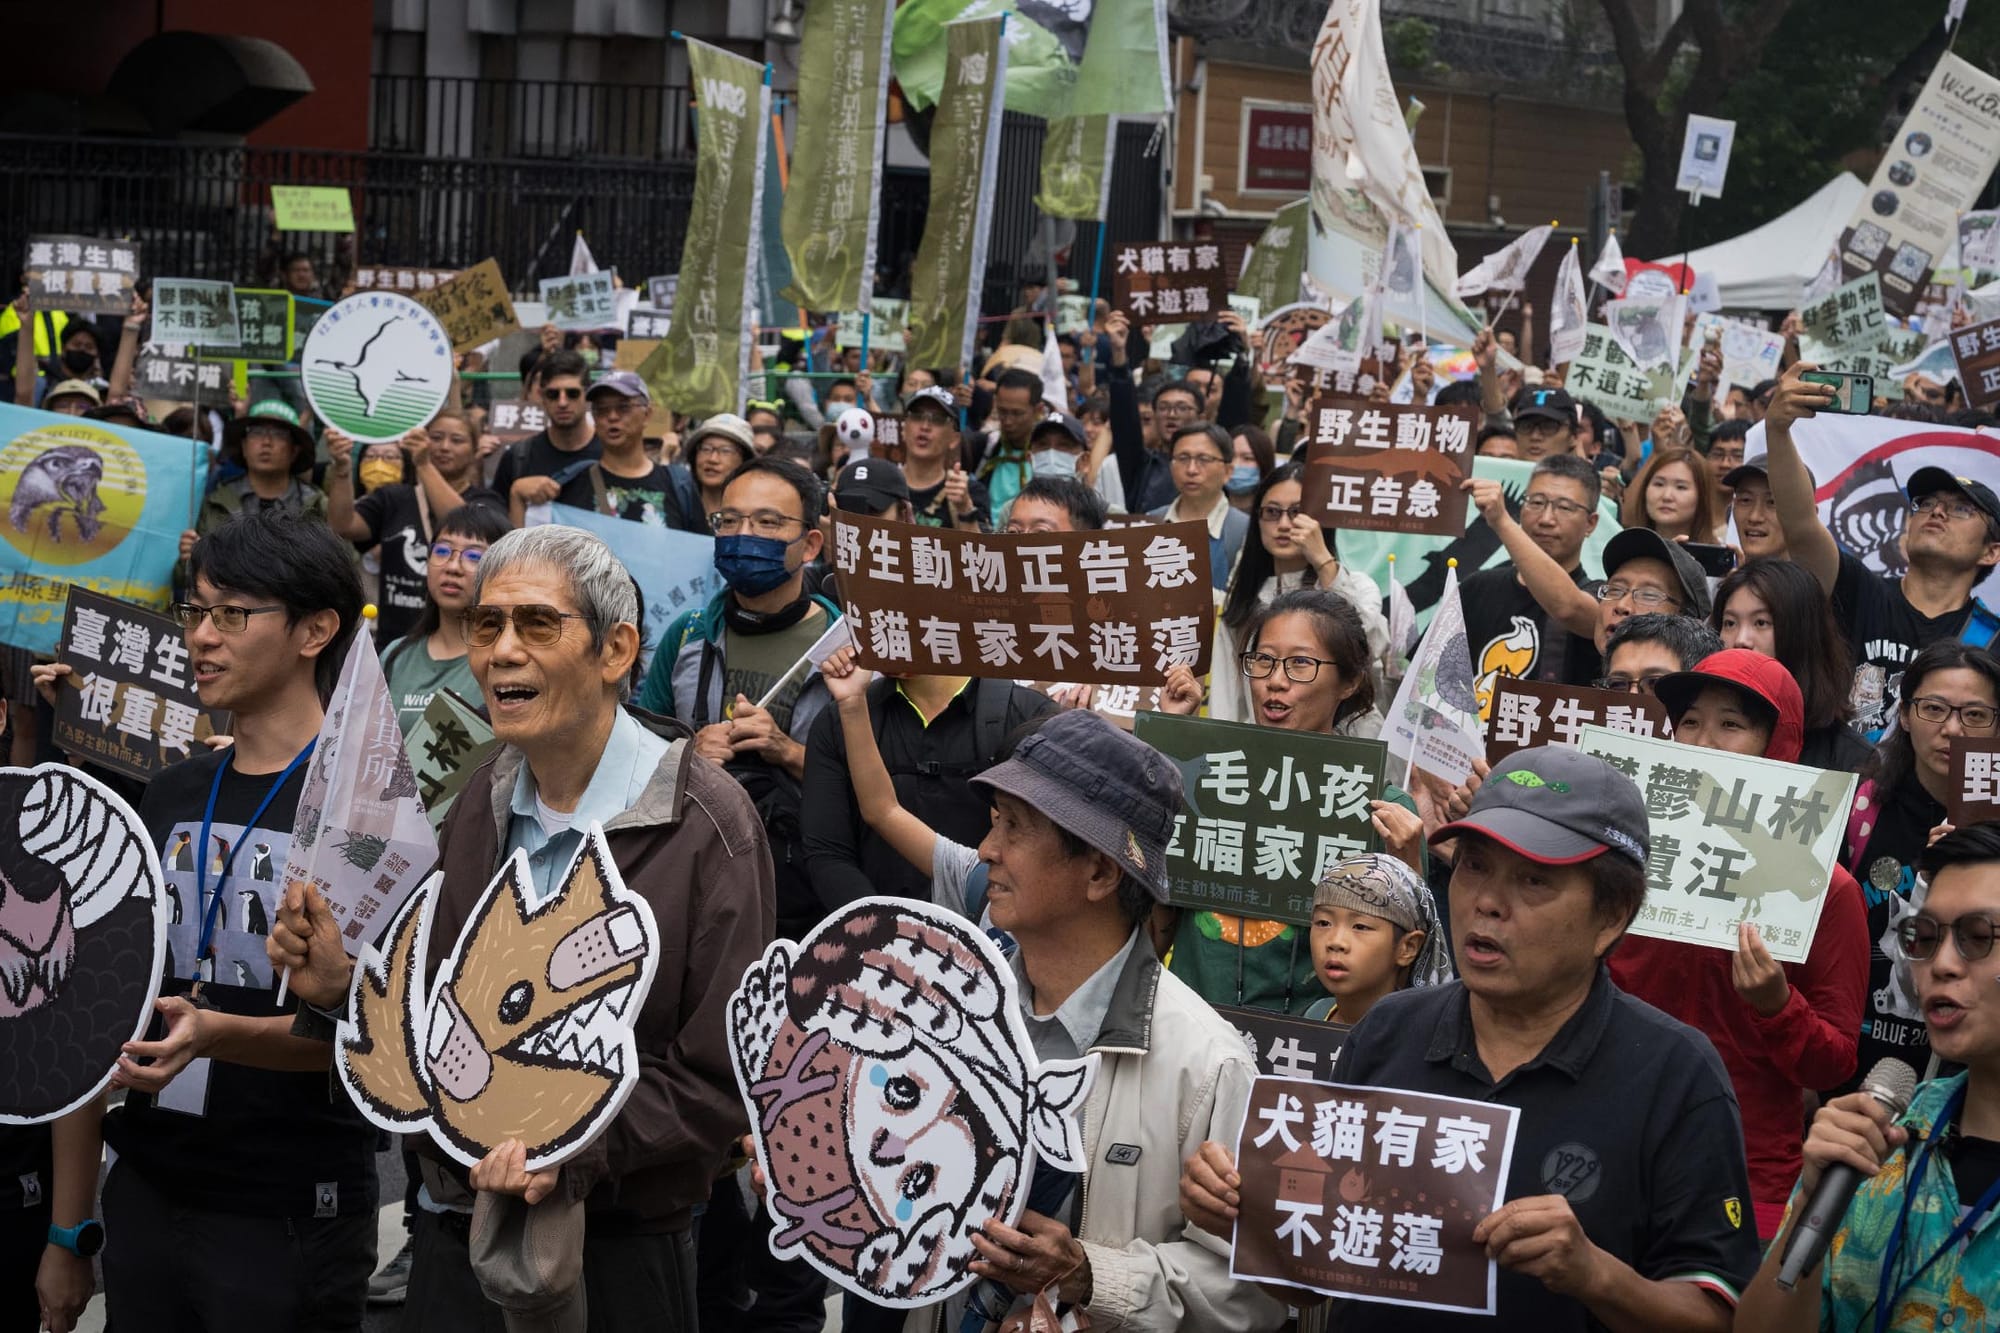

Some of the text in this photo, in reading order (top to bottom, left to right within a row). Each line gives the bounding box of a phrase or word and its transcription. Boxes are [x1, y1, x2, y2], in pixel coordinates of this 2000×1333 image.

[1116, 245, 1220, 275] 犬貓有家
[1129, 286, 1210, 317] 不遊蕩
[1803, 283, 1876, 326] 野生動物
[1825, 307, 1882, 342] 不消亡
[1572, 363, 1648, 402] 不遺汪
[1316, 407, 1471, 454] 野生動物
[855, 467, 868, 480] S
[1326, 474, 1441, 518] 正告急
[835, 520, 1198, 595] 野生動物正告急
[68, 605, 198, 693] 臺灣生
[79, 671, 199, 755] 很重要
[1494, 691, 1674, 748] 野生動
[1201, 750, 1374, 823] 毛小孩
[1872, 1020, 1908, 1046] BLUE
[1253, 1093, 1491, 1174] 犬貓有家
[1274, 1199, 1444, 1276] 不遊蕩
